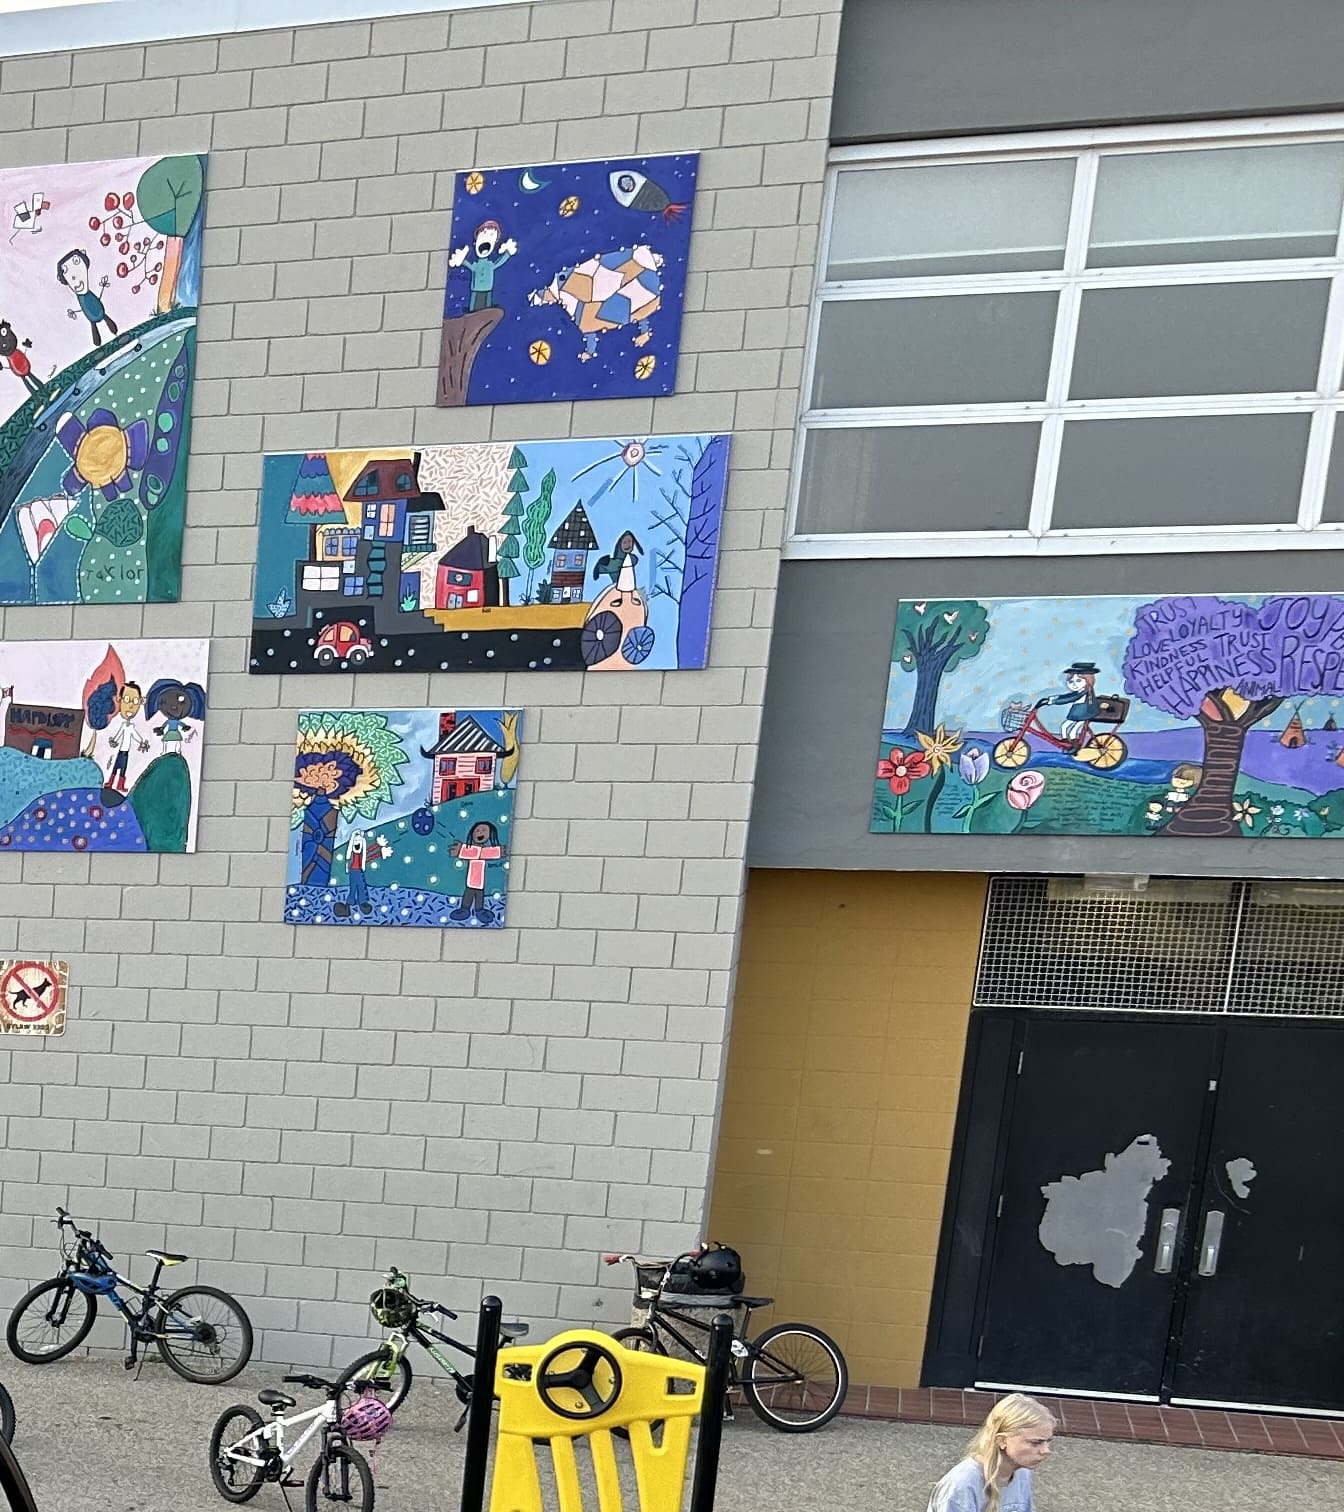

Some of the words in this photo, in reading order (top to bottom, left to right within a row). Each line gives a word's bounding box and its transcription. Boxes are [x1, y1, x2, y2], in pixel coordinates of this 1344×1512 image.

[1139, 597, 1198, 635] TRUST
[1169, 608, 1244, 642] LOYALTY
[1258, 597, 1330, 638] JOY
[1130, 639, 1208, 680] KINDNESS
[1132, 639, 1171, 659] LOVE
[1213, 632, 1272, 656] TRUST
[1139, 656, 1209, 697] HELPFUL
[1161, 648, 1277, 715] HAPPINESS
